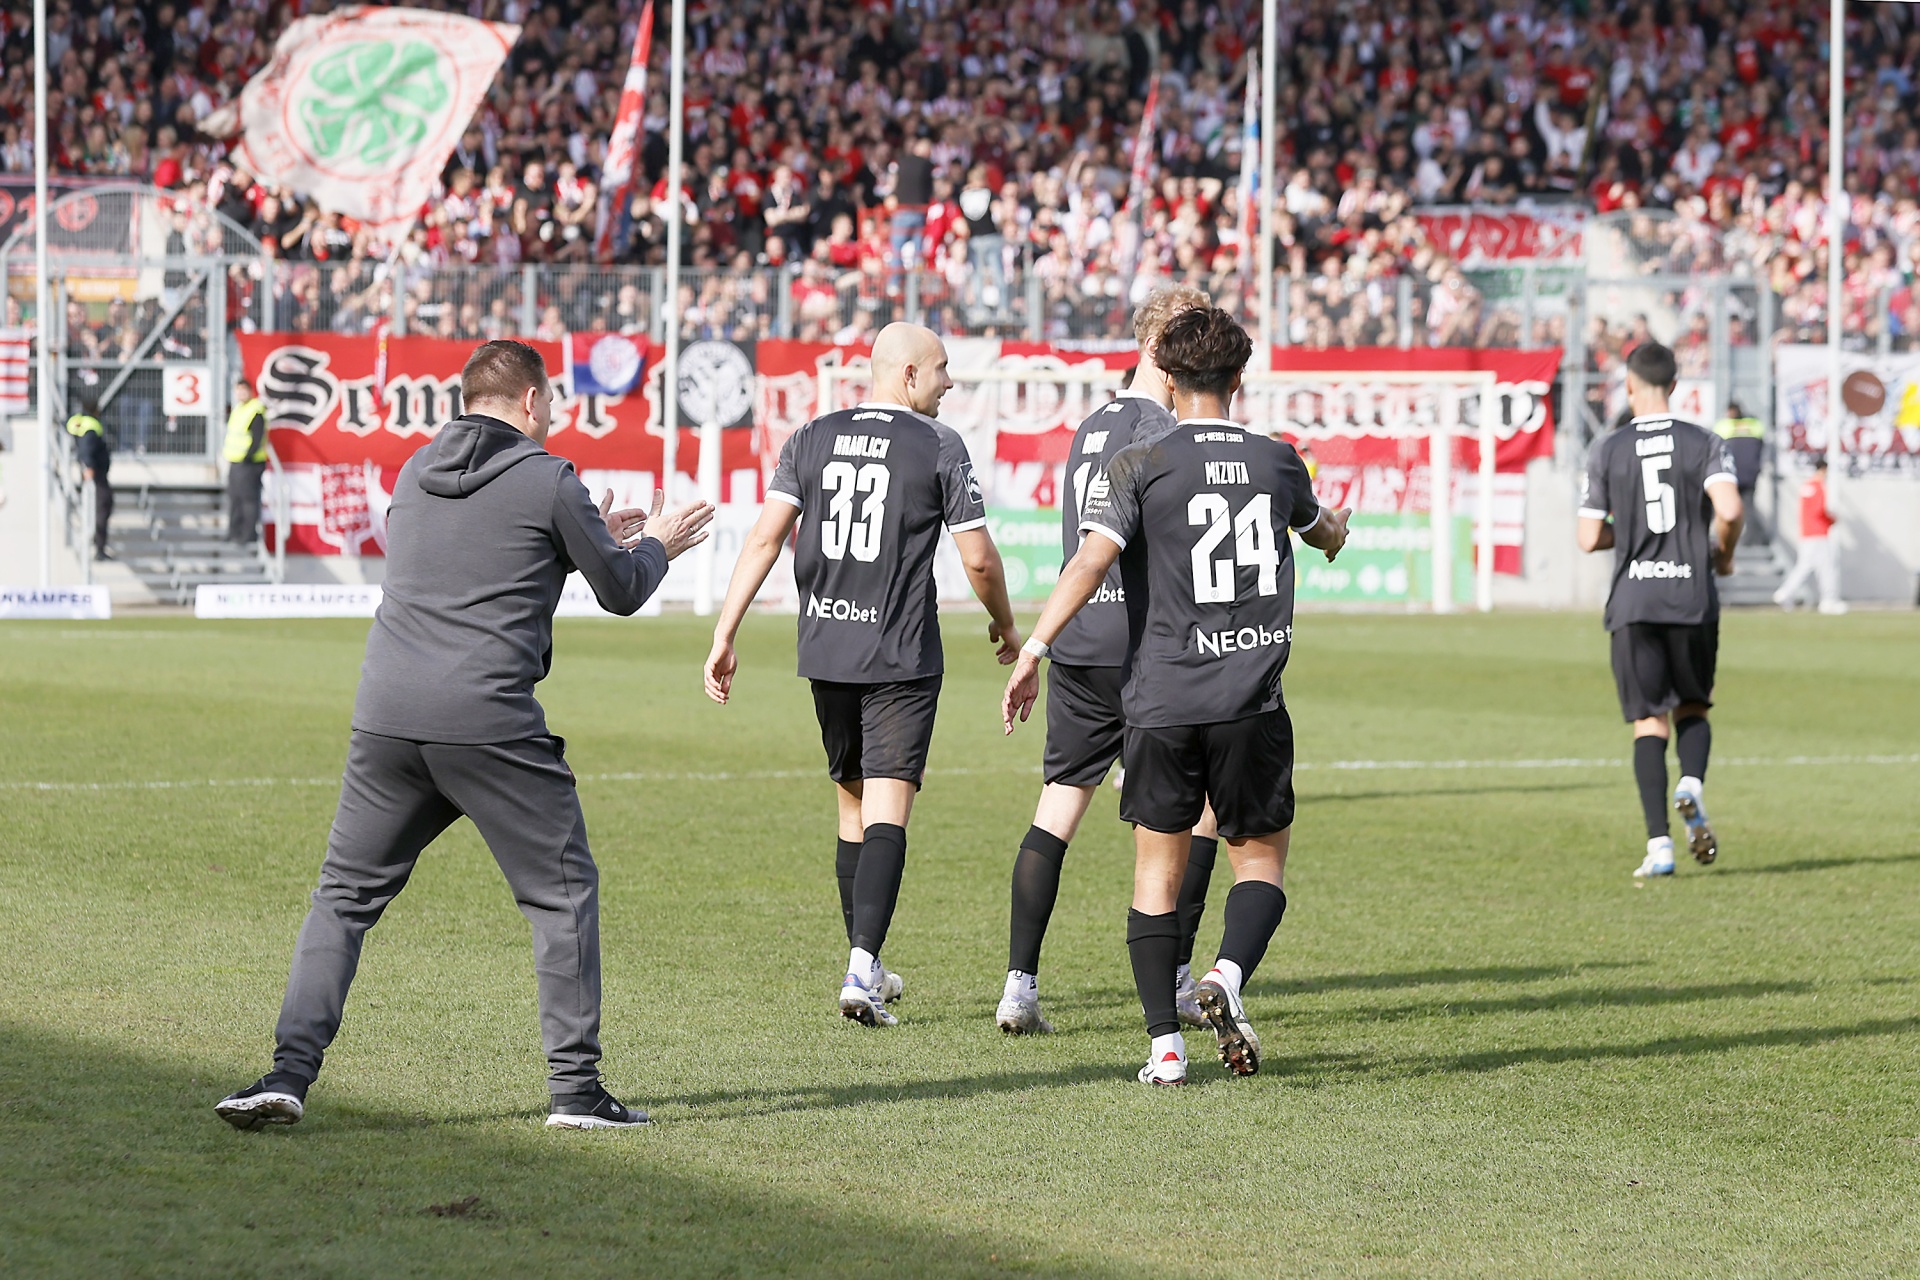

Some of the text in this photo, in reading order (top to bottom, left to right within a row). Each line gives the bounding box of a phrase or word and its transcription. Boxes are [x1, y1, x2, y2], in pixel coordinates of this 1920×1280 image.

[175, 369, 200, 406] 3
[1681, 386, 1703, 417] 4
[1204, 461, 1250, 485] MIZUTA
[1641, 454, 1677, 535] 5
[821, 461, 891, 563] 33
[1187, 492, 1280, 605] 24
